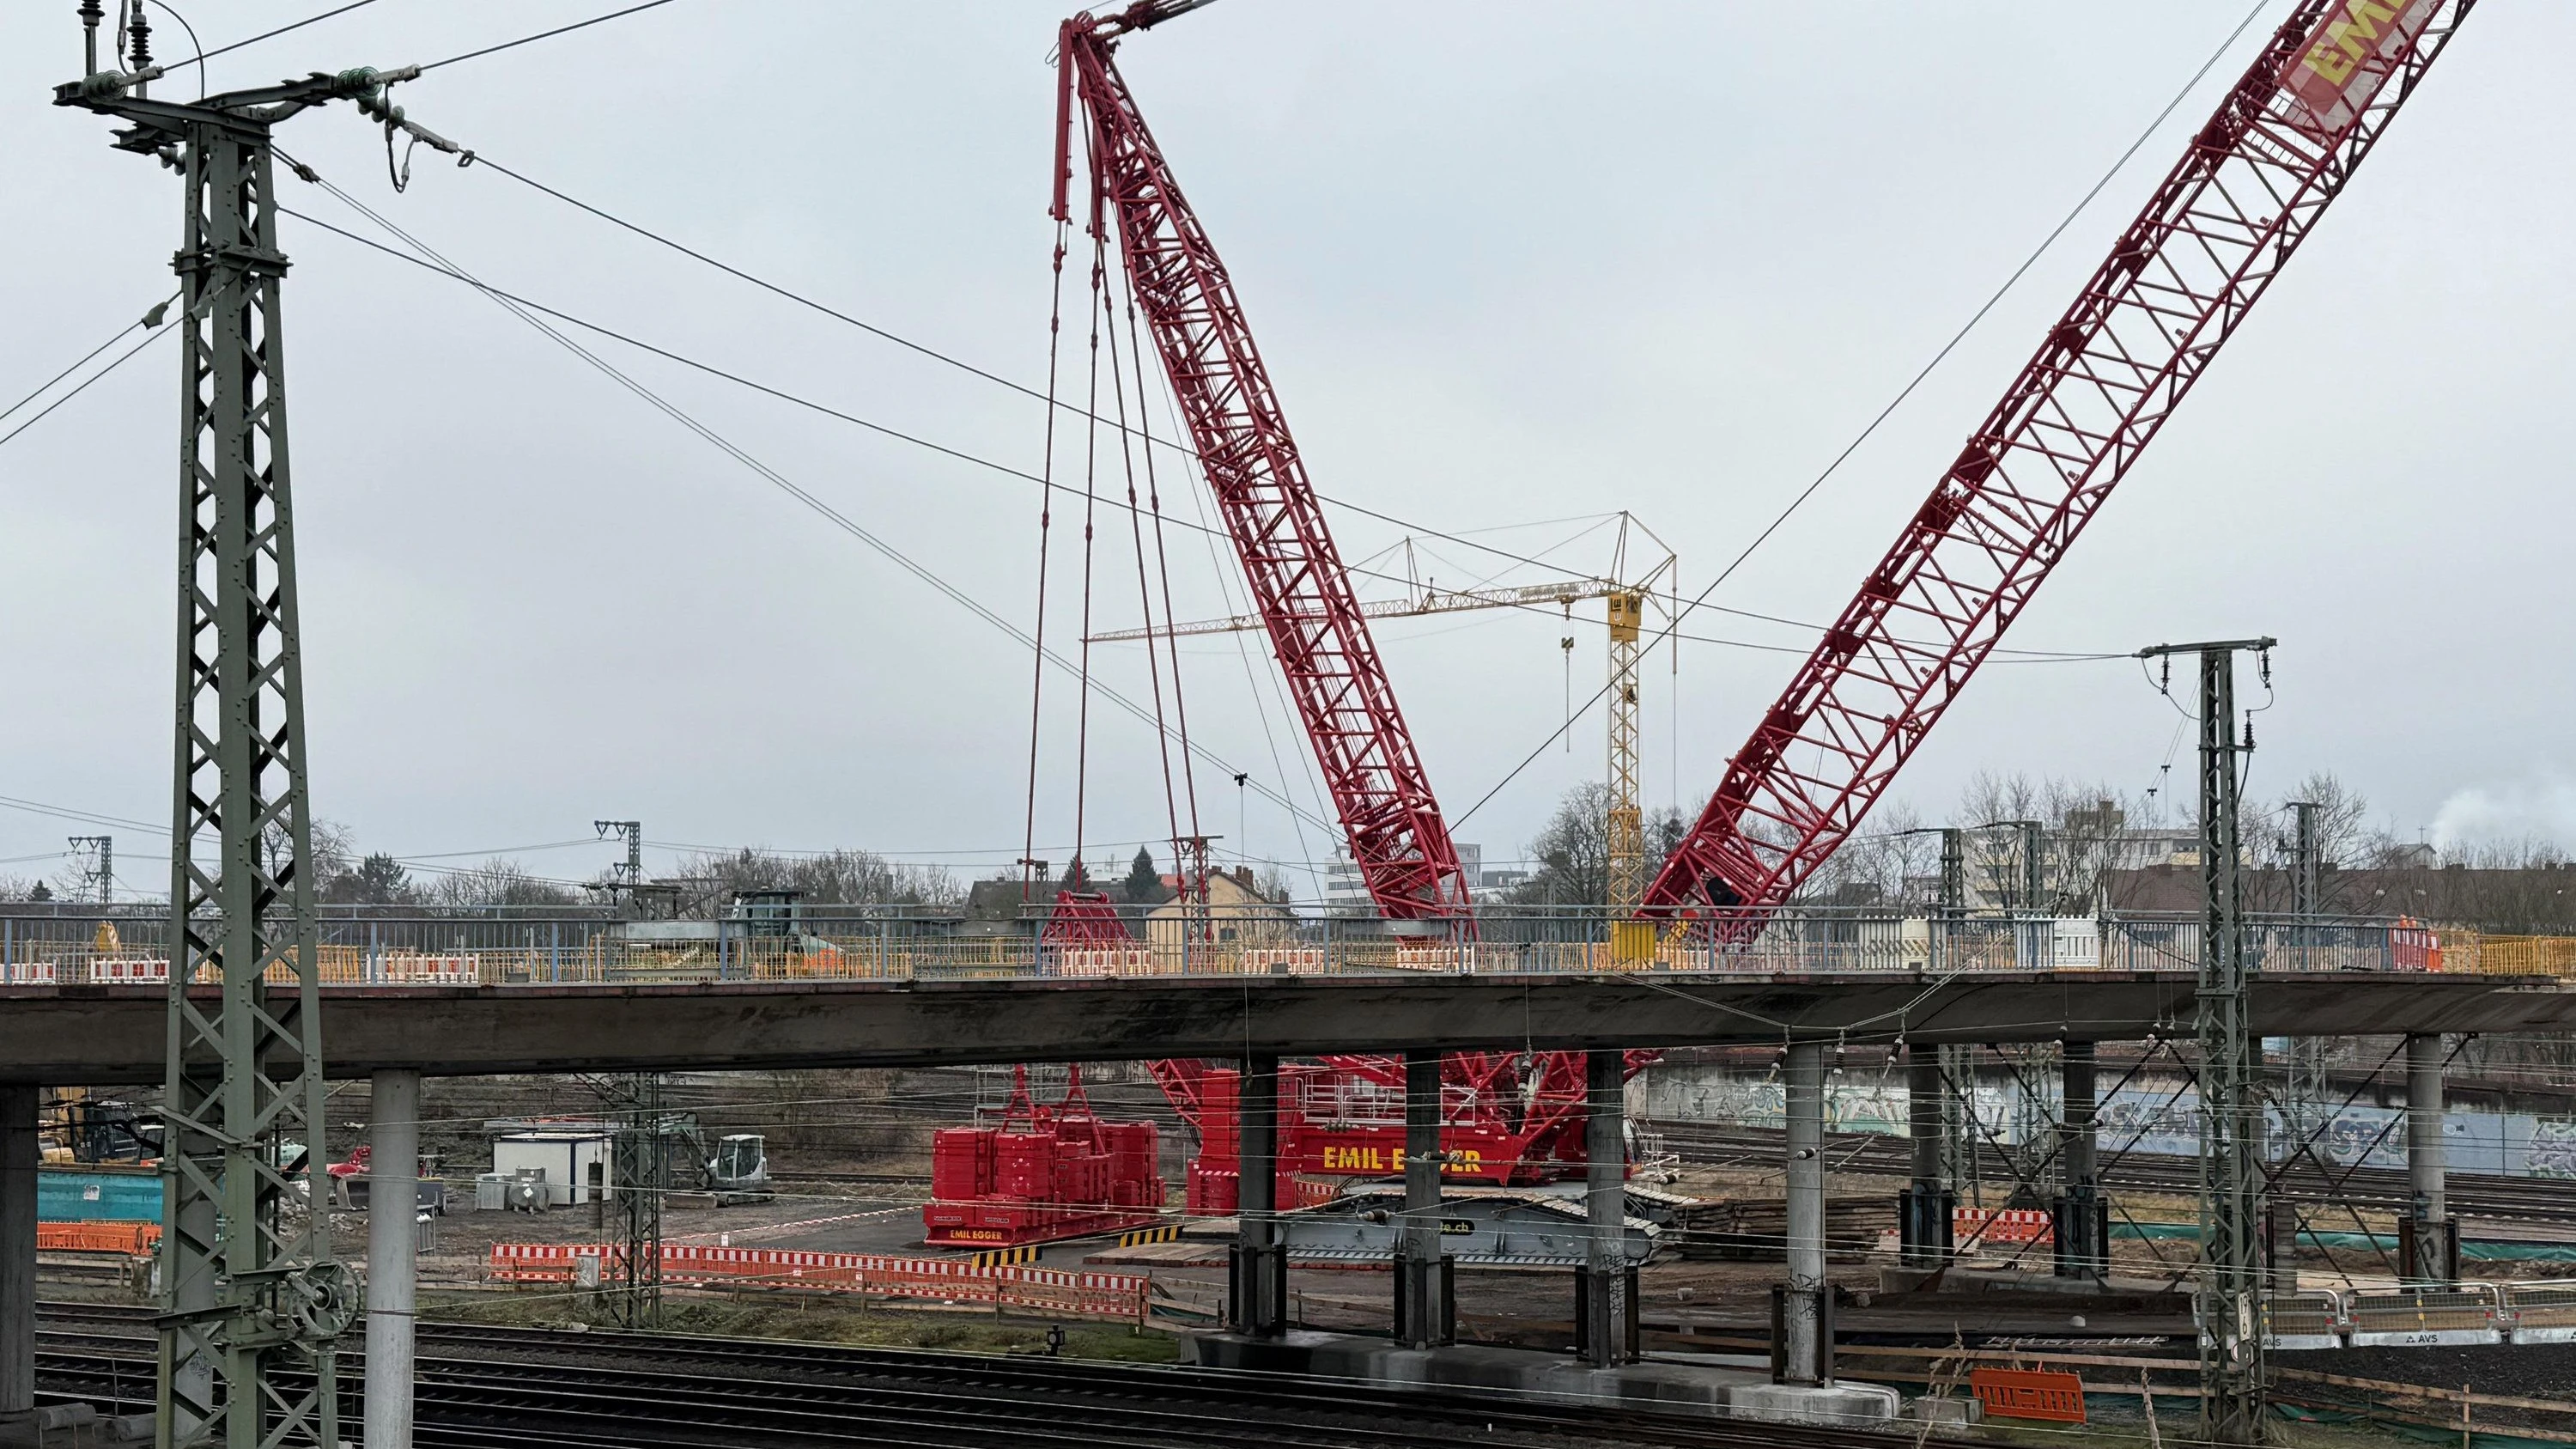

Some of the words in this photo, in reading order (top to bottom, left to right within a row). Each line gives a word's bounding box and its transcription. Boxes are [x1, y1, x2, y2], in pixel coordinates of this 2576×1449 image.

[2303, 0, 2403, 86] EM
[1324, 1147, 1383, 1169] EMIL
[1393, 1148, 1482, 1172] EER
[951, 1229, 970, 1239] EMIL
[973, 1230, 1002, 1240] EGGER
[2418, 1335, 2439, 1343] AVS
